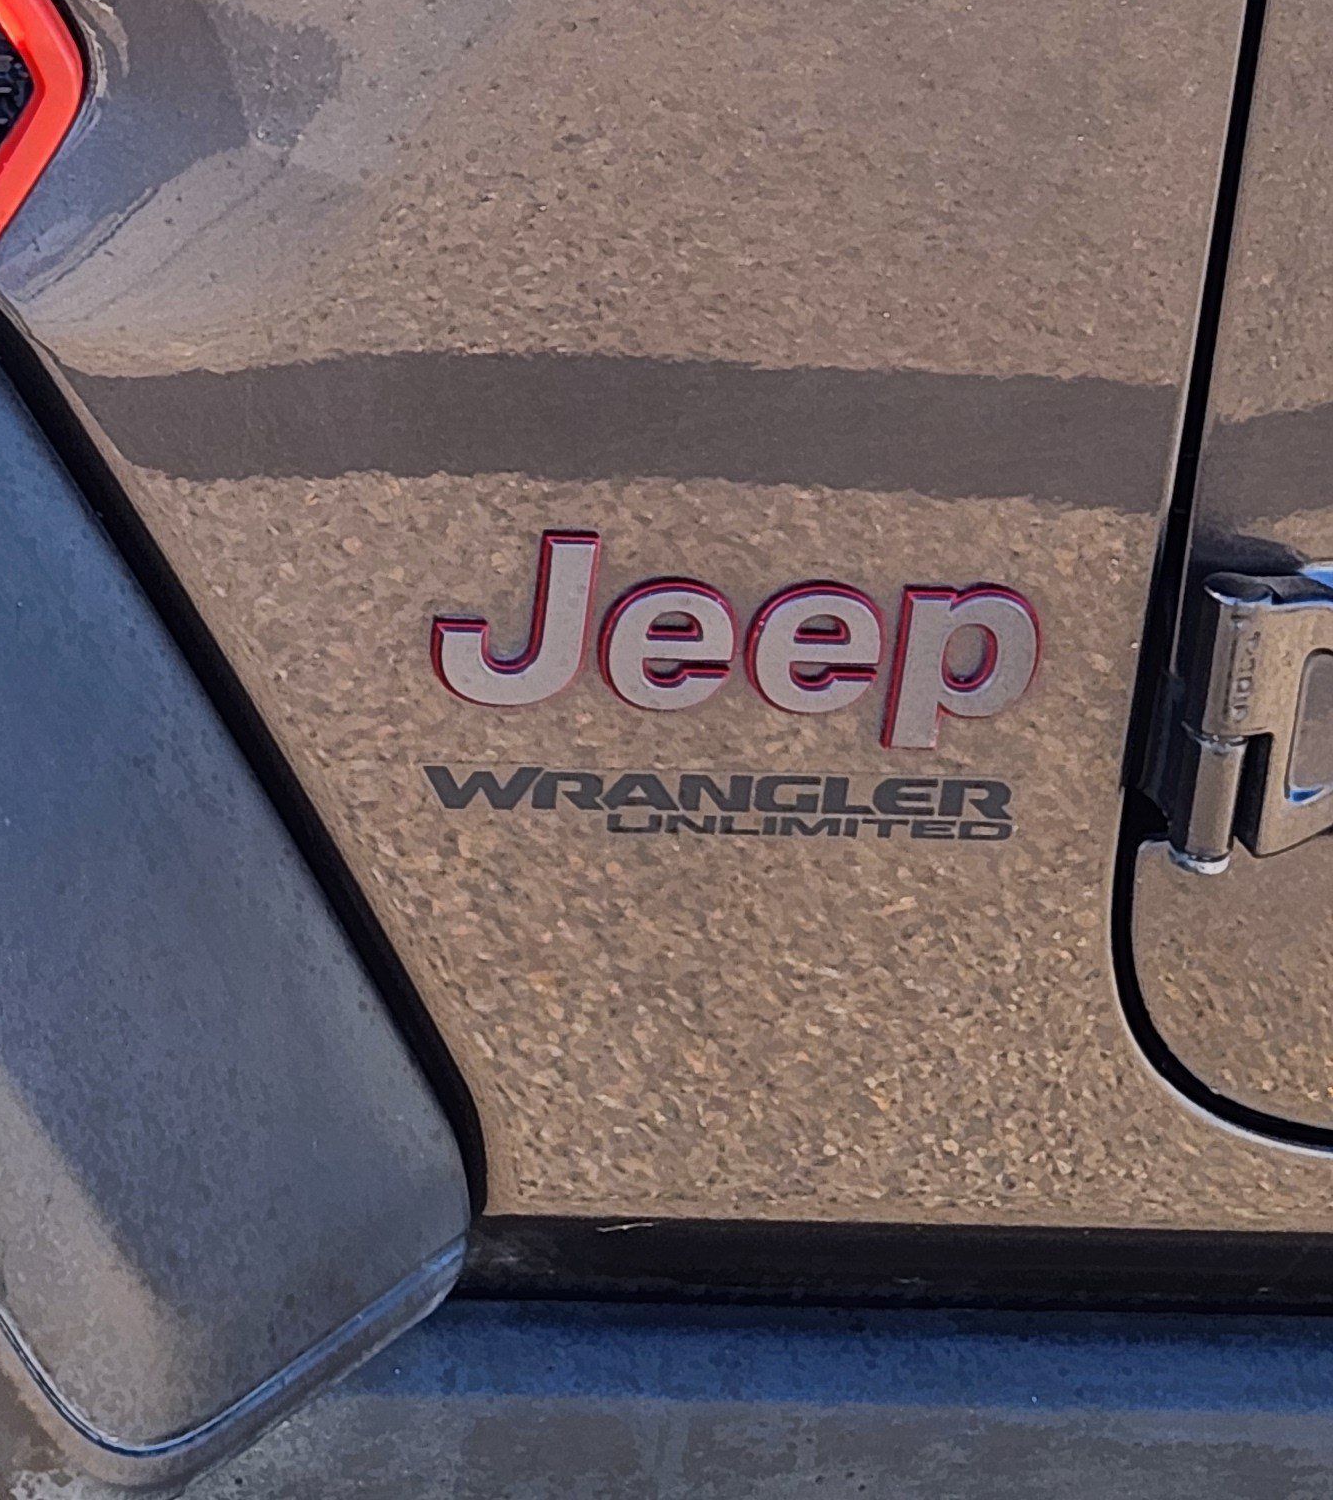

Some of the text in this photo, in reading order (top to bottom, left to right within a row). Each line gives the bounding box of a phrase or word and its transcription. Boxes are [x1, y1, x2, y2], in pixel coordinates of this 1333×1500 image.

[431, 529, 1042, 750] Jeep
[423, 765, 1013, 821] WRANGLER
[606, 812, 1013, 842] UNLIMITED
